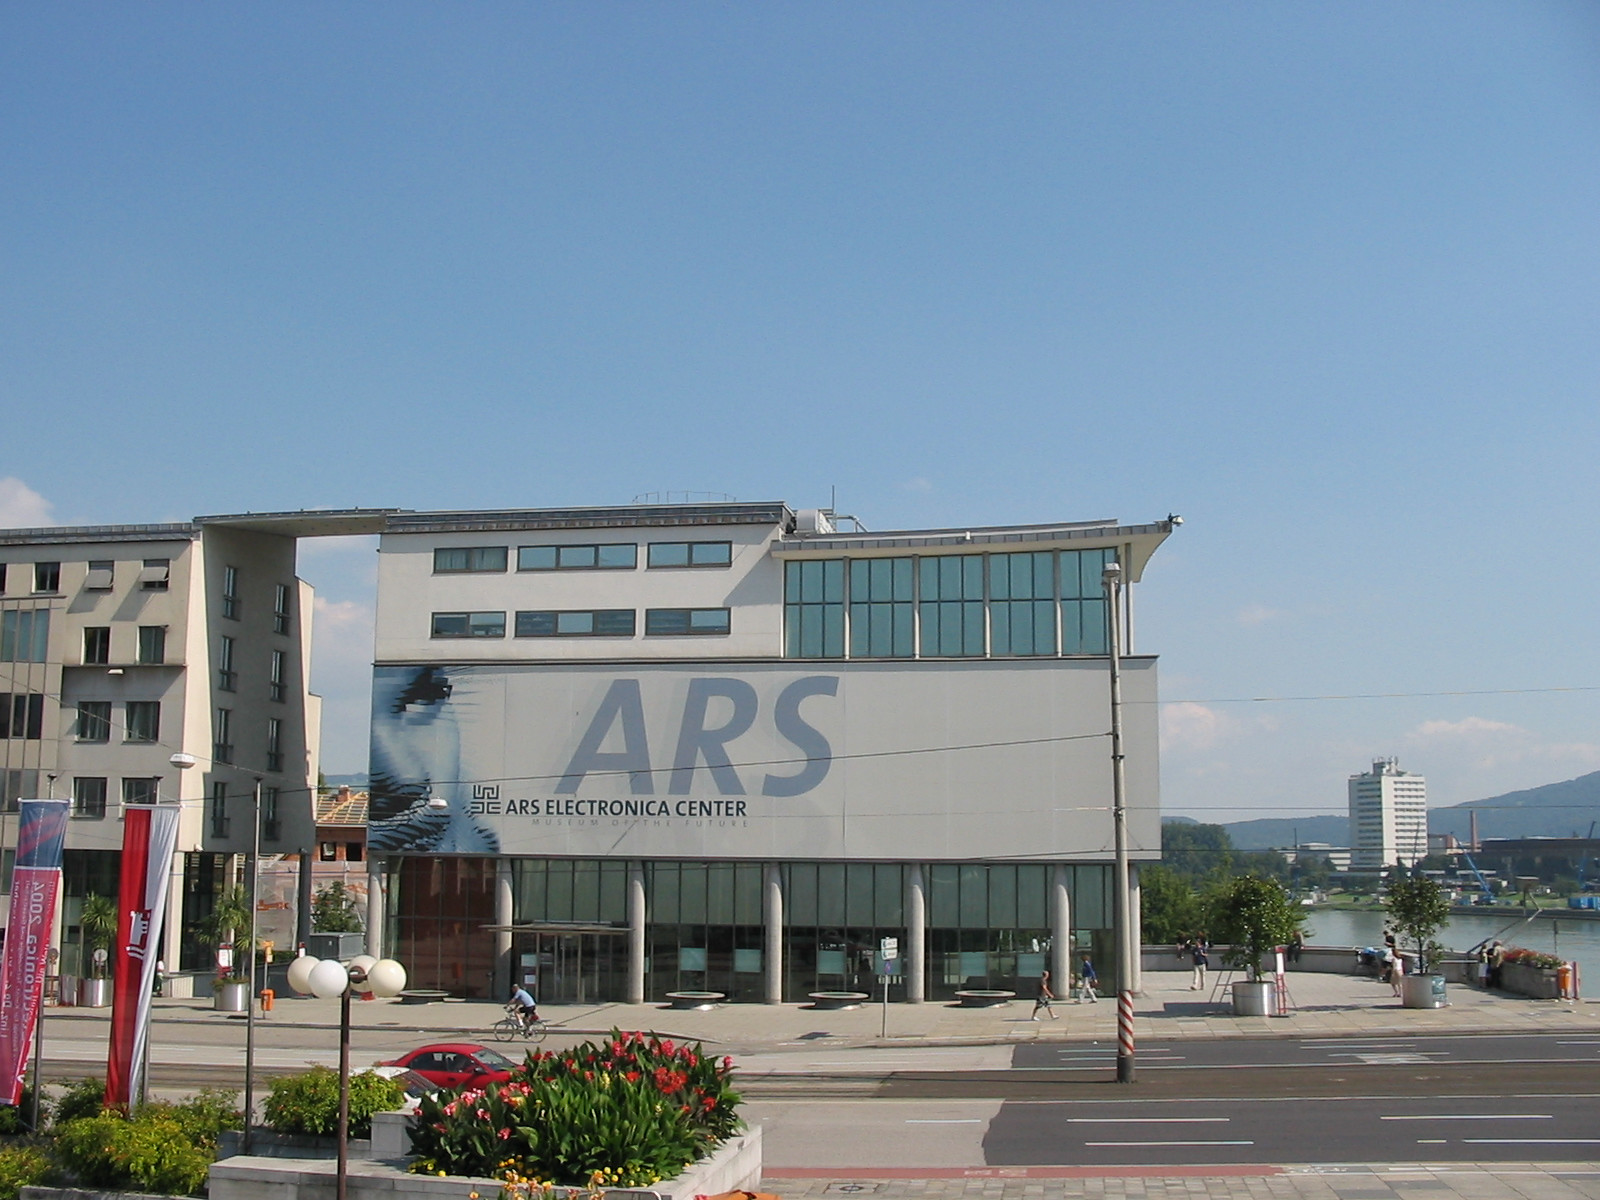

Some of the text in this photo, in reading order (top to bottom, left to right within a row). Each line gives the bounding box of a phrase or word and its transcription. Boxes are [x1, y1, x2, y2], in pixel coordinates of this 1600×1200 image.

[553, 675, 840, 797] ARS
[505, 799, 747, 817] ARS ELECTRONICA CENTER
[531, 818, 599, 827] MUSEUM
[643, 819, 671, 828] THE
[684, 819, 748, 828] FUTURE
